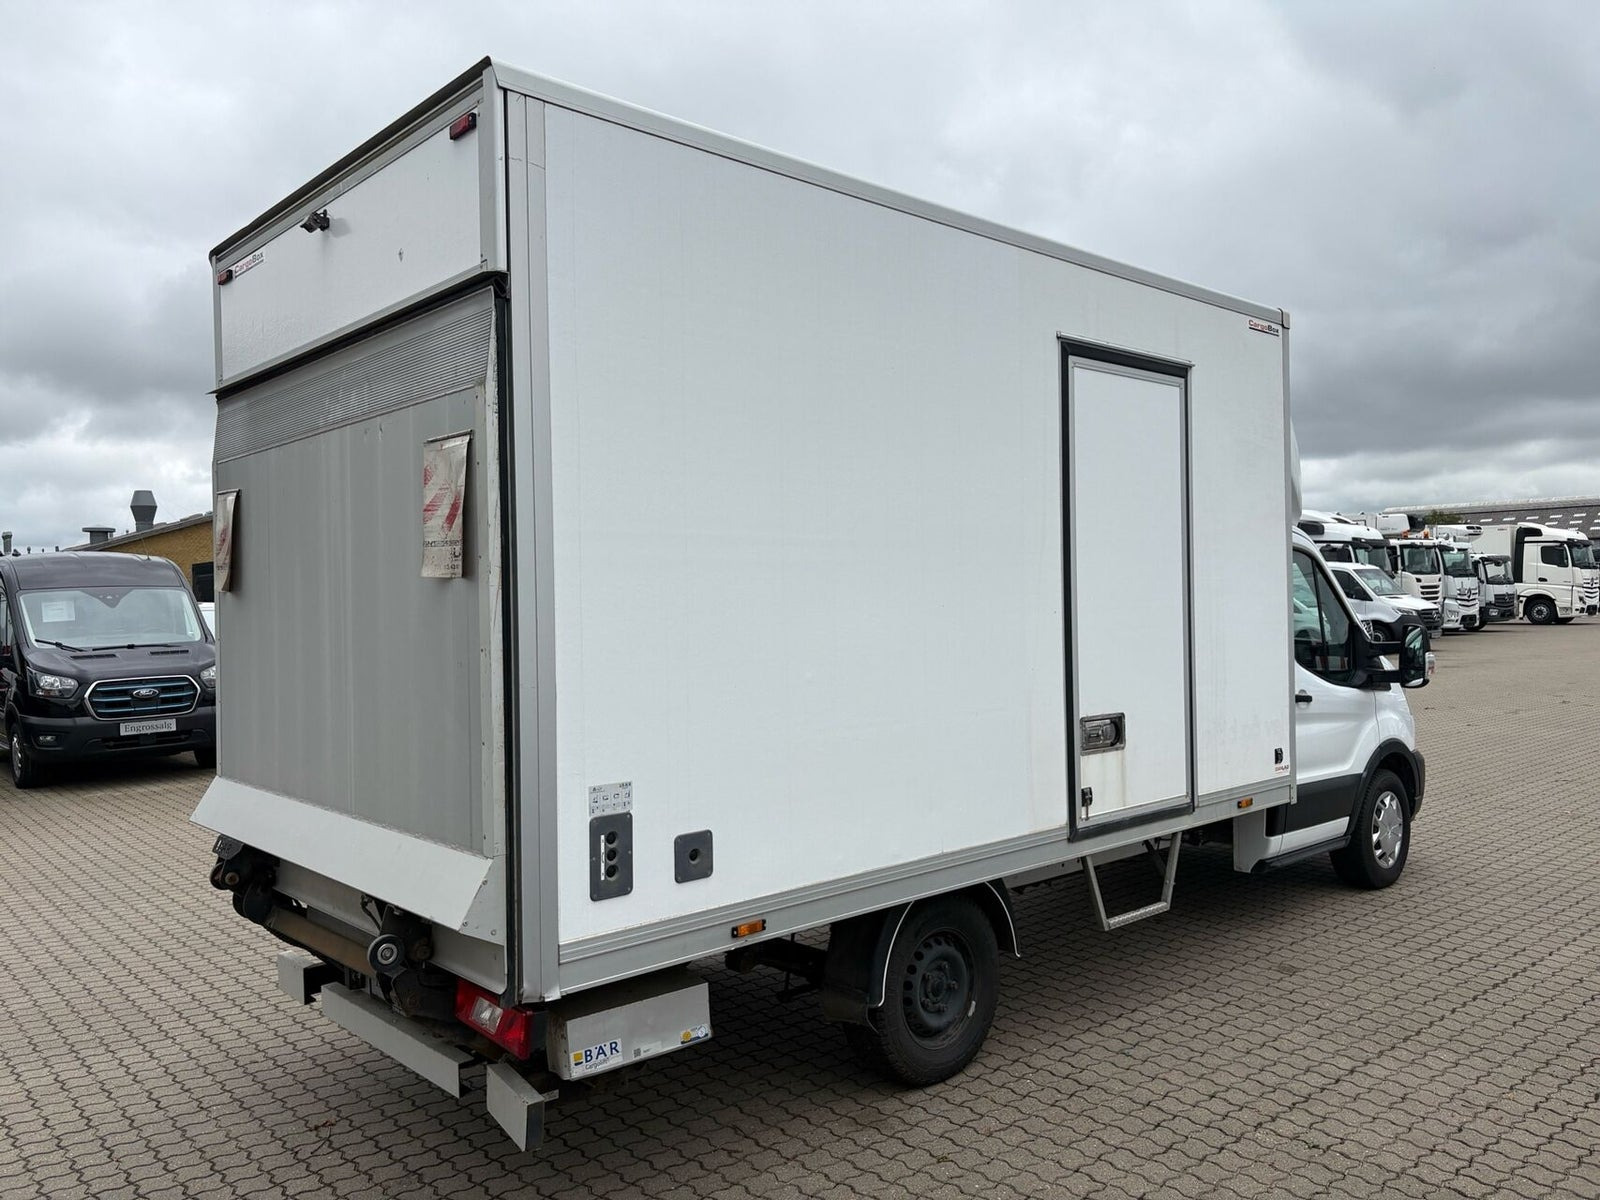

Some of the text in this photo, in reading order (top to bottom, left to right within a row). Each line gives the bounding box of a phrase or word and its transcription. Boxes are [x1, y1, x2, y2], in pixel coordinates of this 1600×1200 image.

[1248, 319, 1279, 333] CargoBox
[124, 721, 173, 733] Engrossalg
[584, 1041, 620, 1063] BÄR
